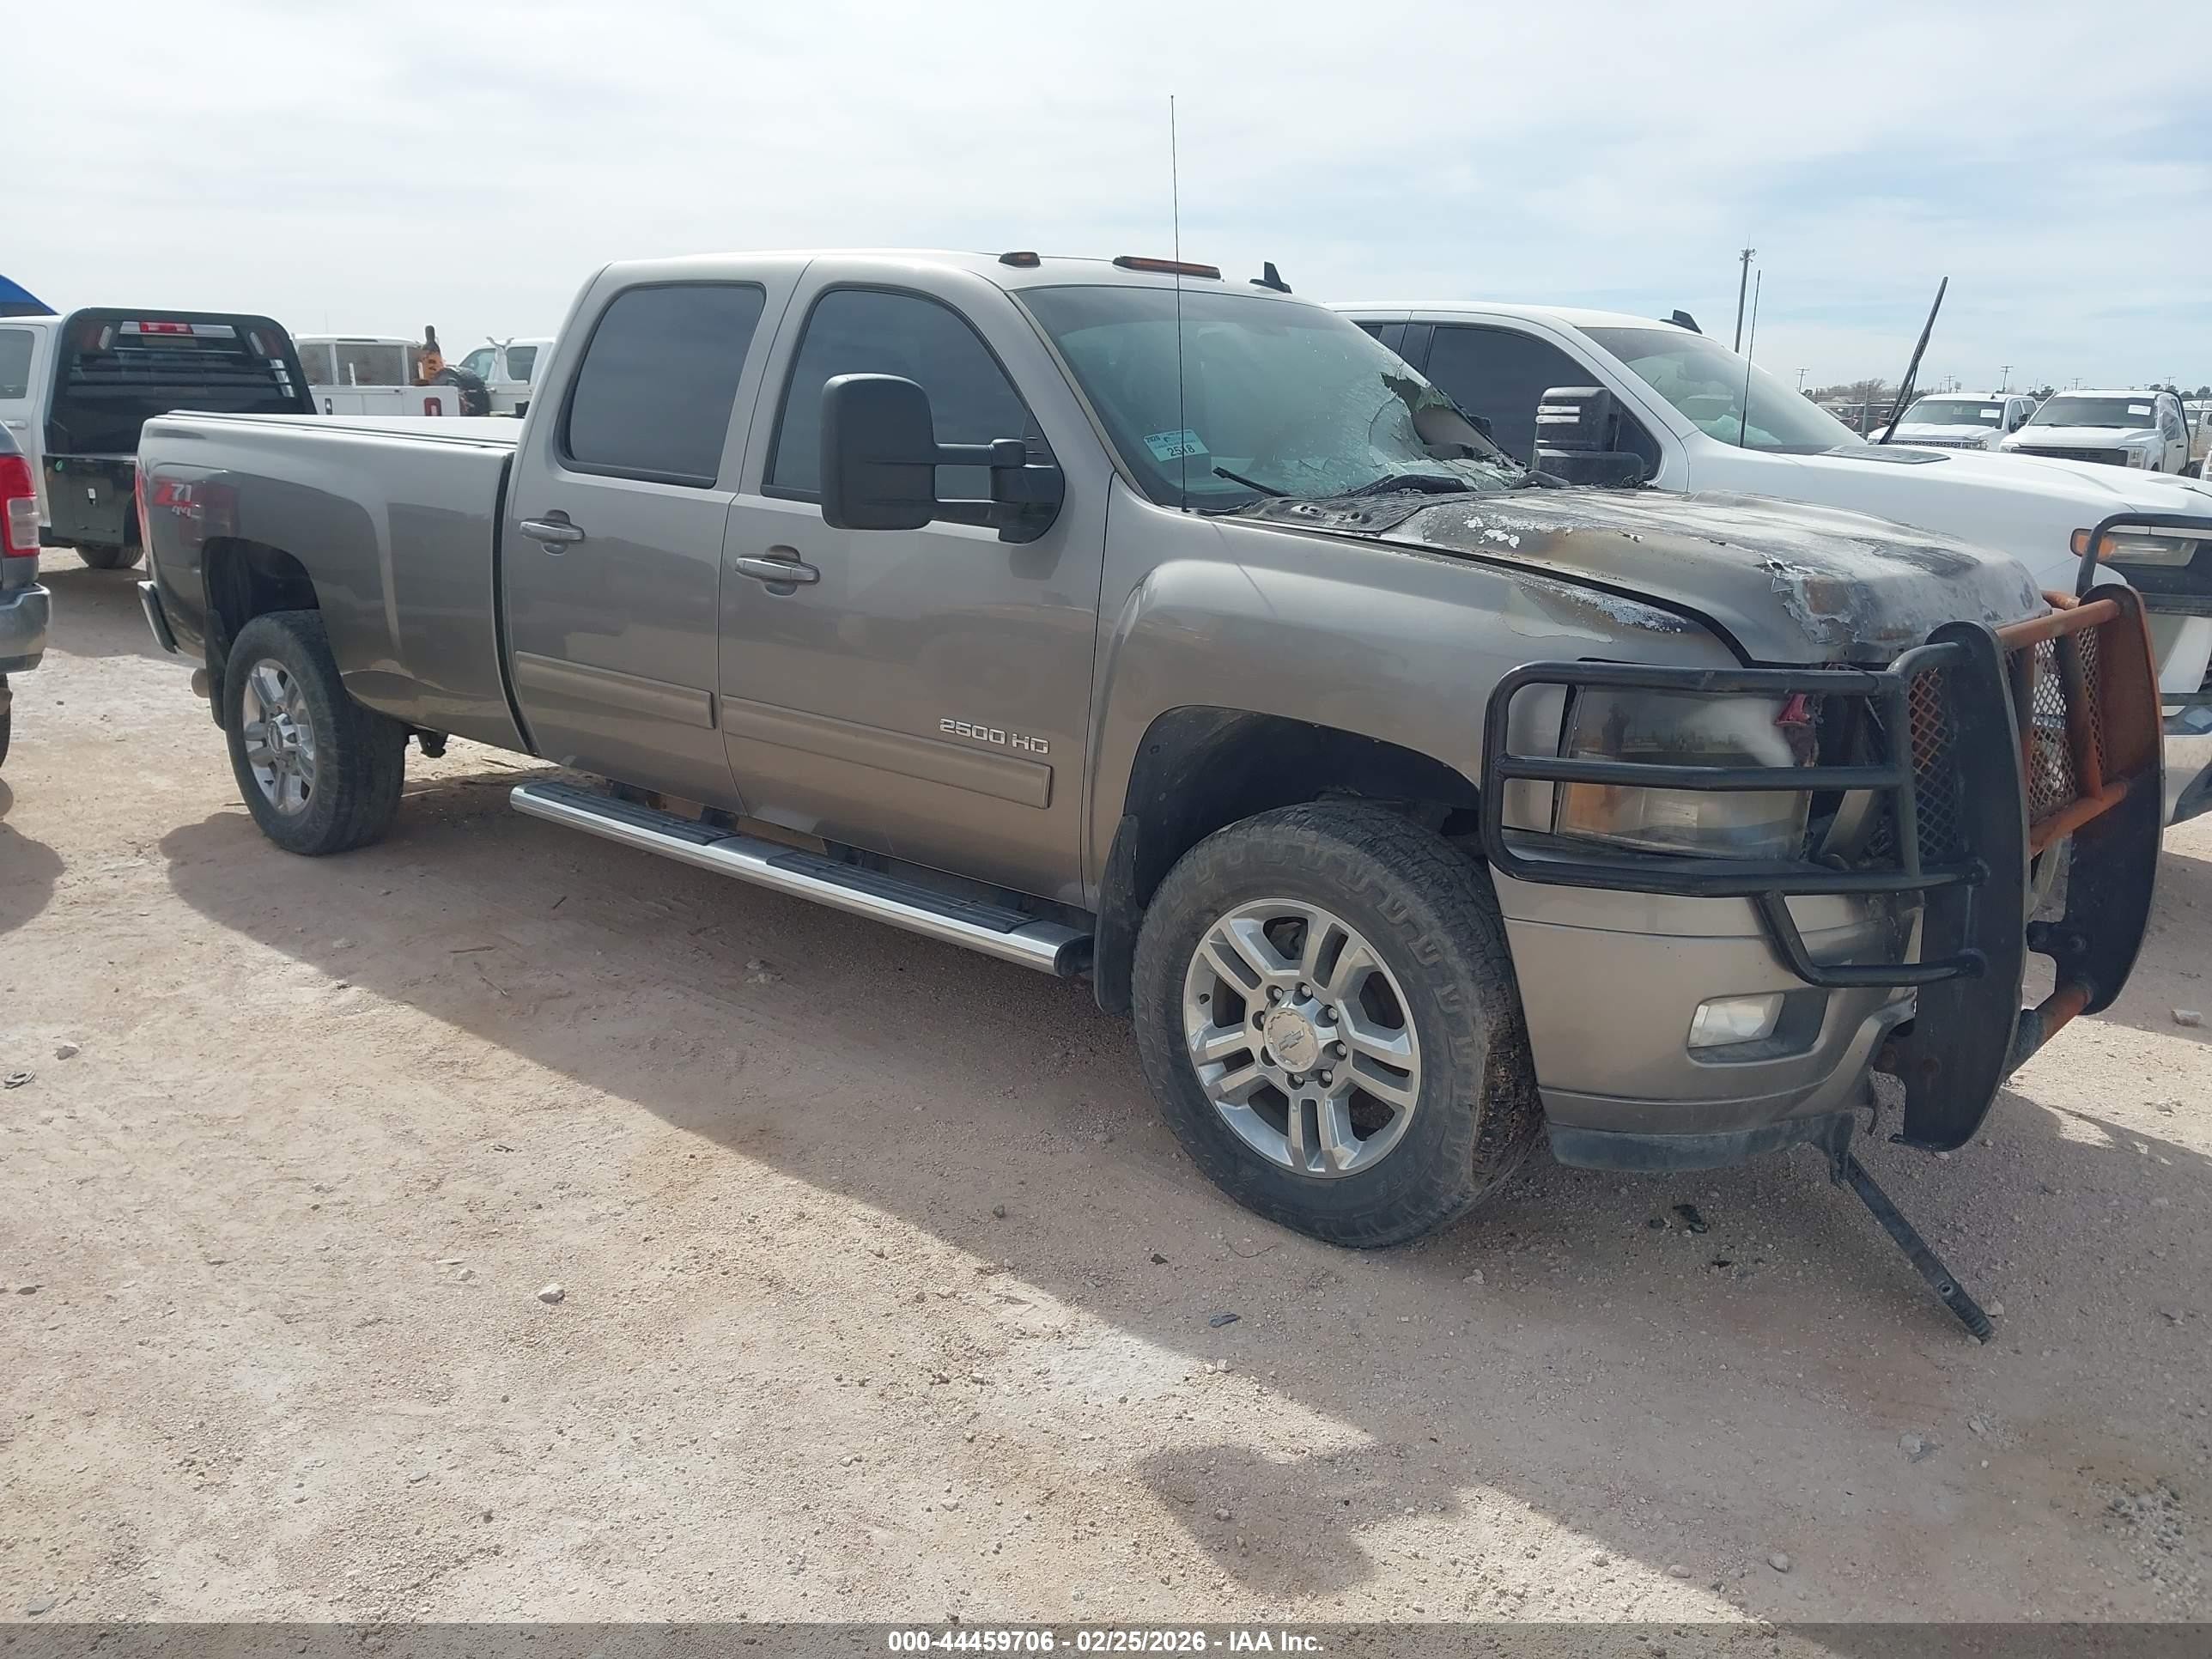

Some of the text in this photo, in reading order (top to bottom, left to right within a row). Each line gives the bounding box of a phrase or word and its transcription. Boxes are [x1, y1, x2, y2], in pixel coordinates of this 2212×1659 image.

[155, 481, 192, 506] Z71
[939, 718, 1050, 755] 2500 HD
